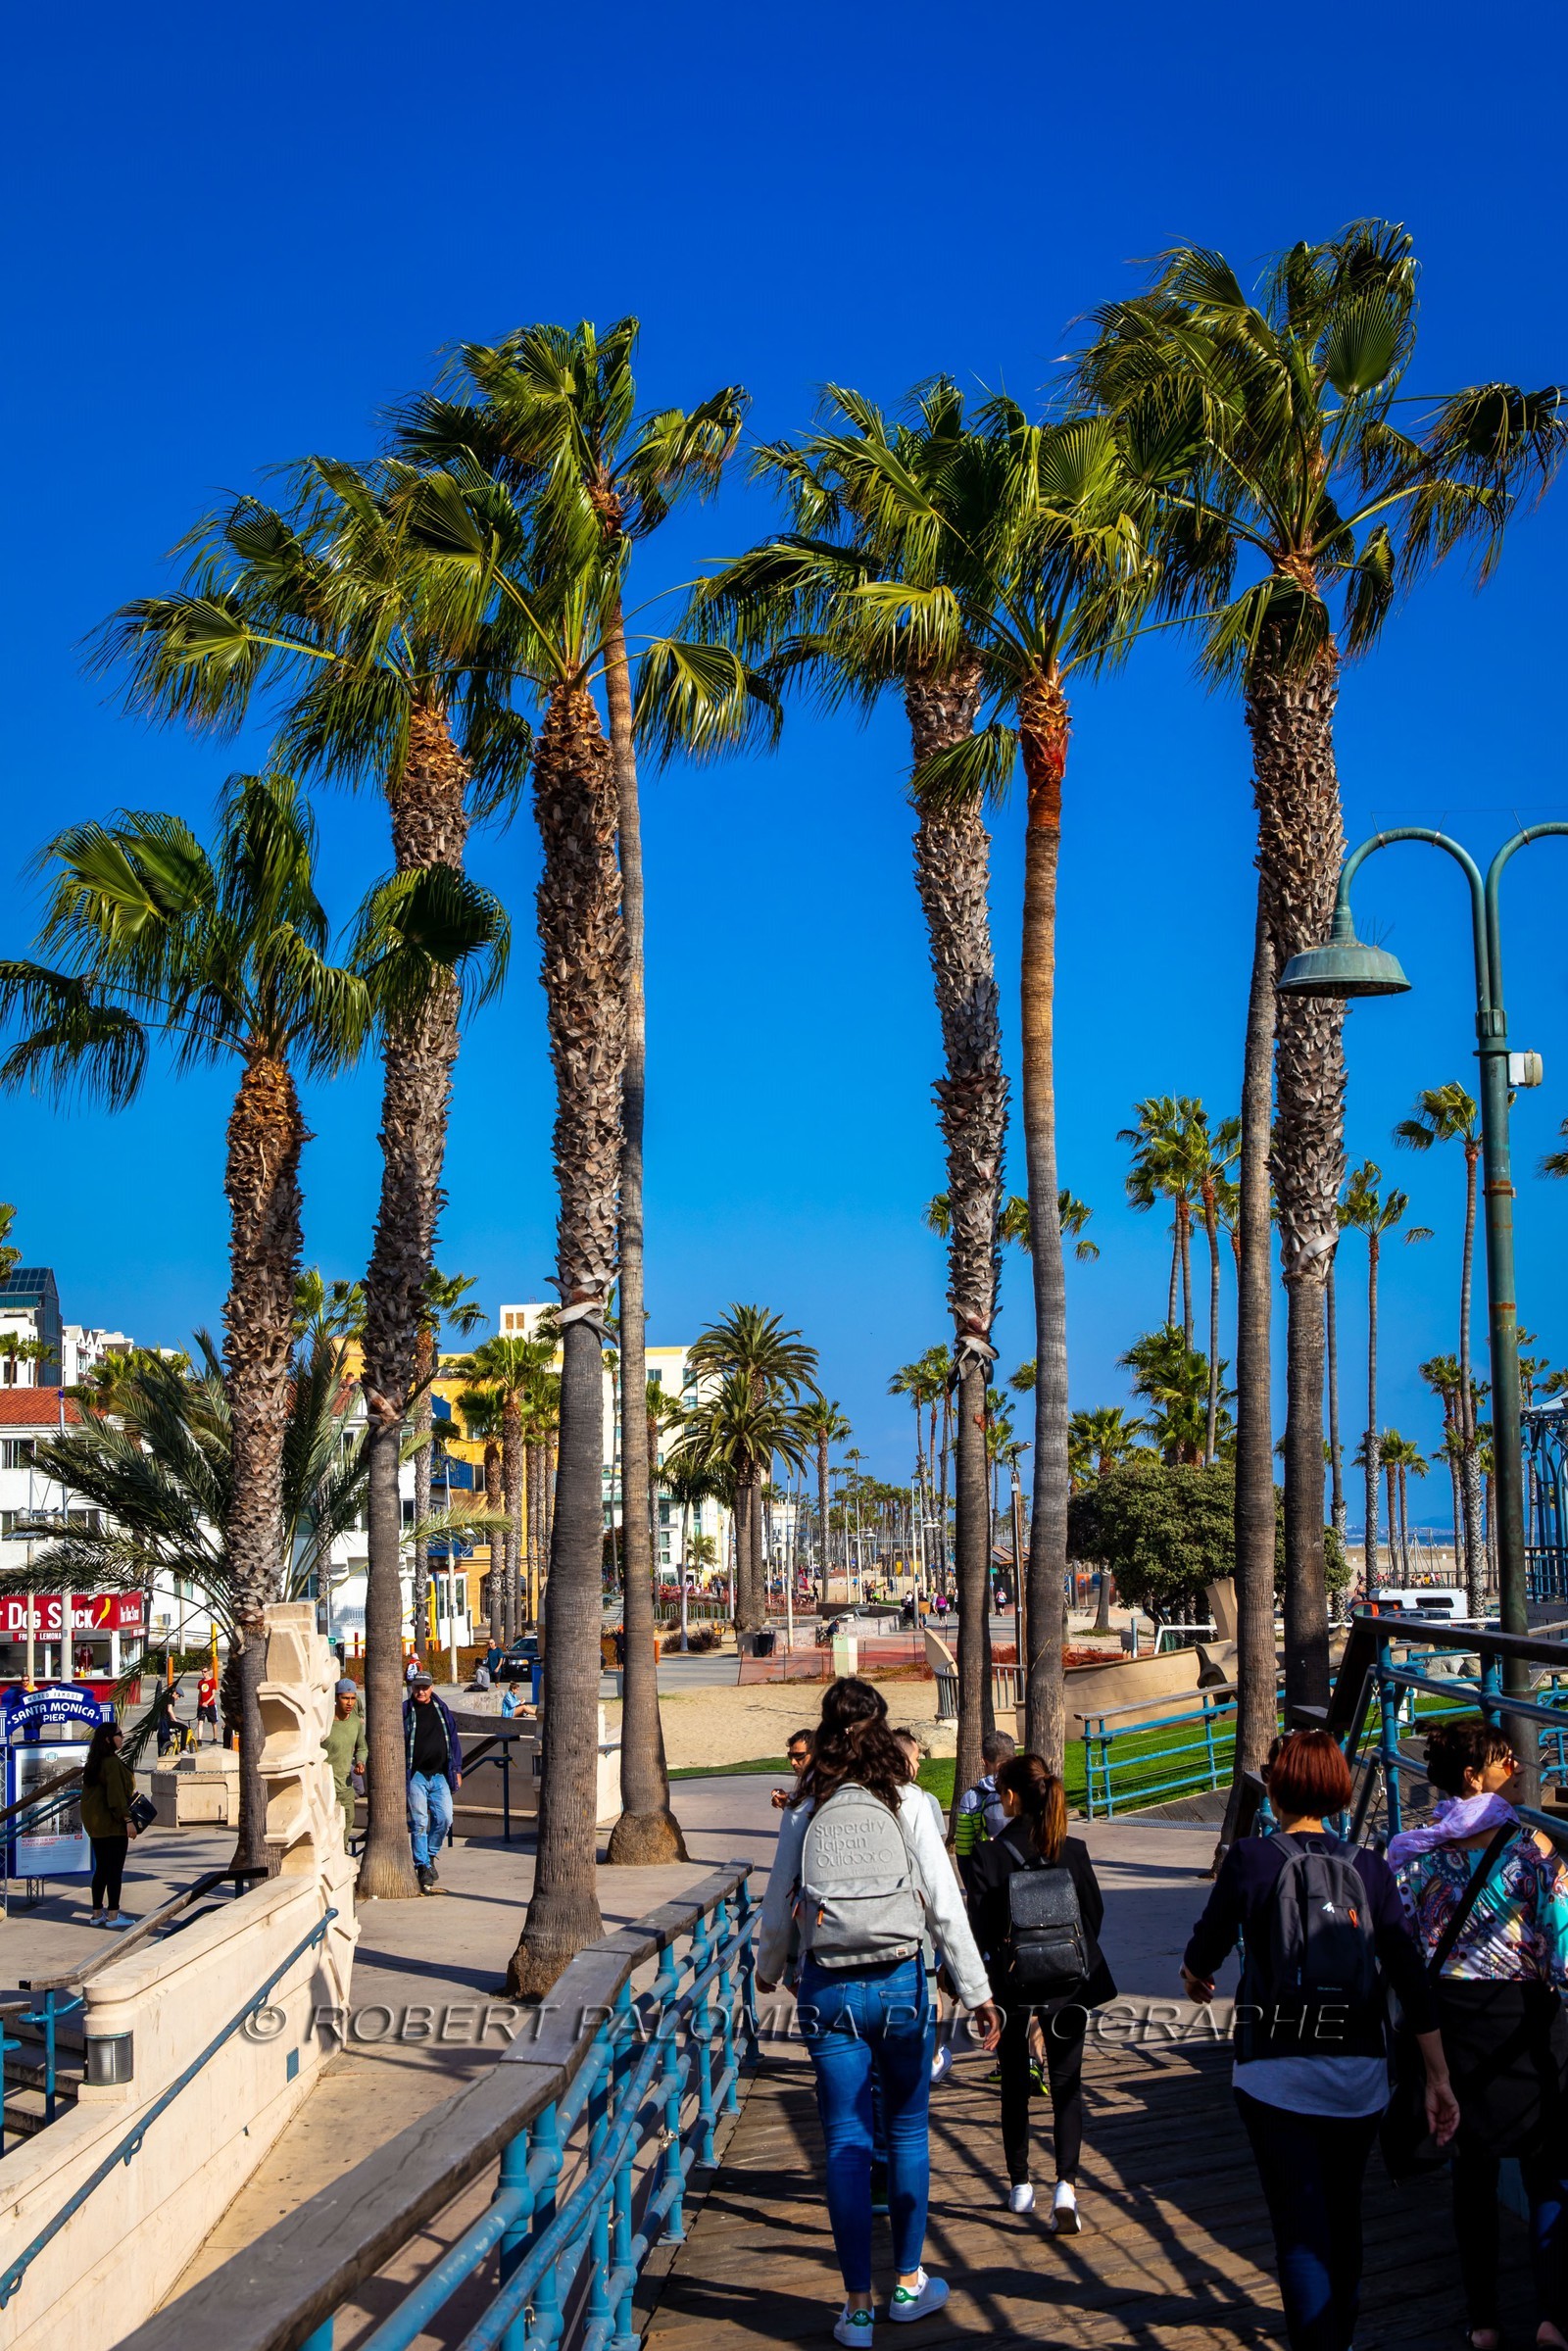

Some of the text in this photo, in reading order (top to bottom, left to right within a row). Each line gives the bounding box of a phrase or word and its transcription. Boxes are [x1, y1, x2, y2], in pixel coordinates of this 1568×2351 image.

[48, 1602, 94, 1629] SICK
[27, 1692, 49, 1701] WORLD
[12, 1702, 95, 1724] SANTA MONICA
[43, 1713, 66, 1722] PIER
[814, 1819, 886, 1838] Superdry
[815, 1837, 867, 1853] Japan
[816, 1851, 876, 1868] Outdoor
